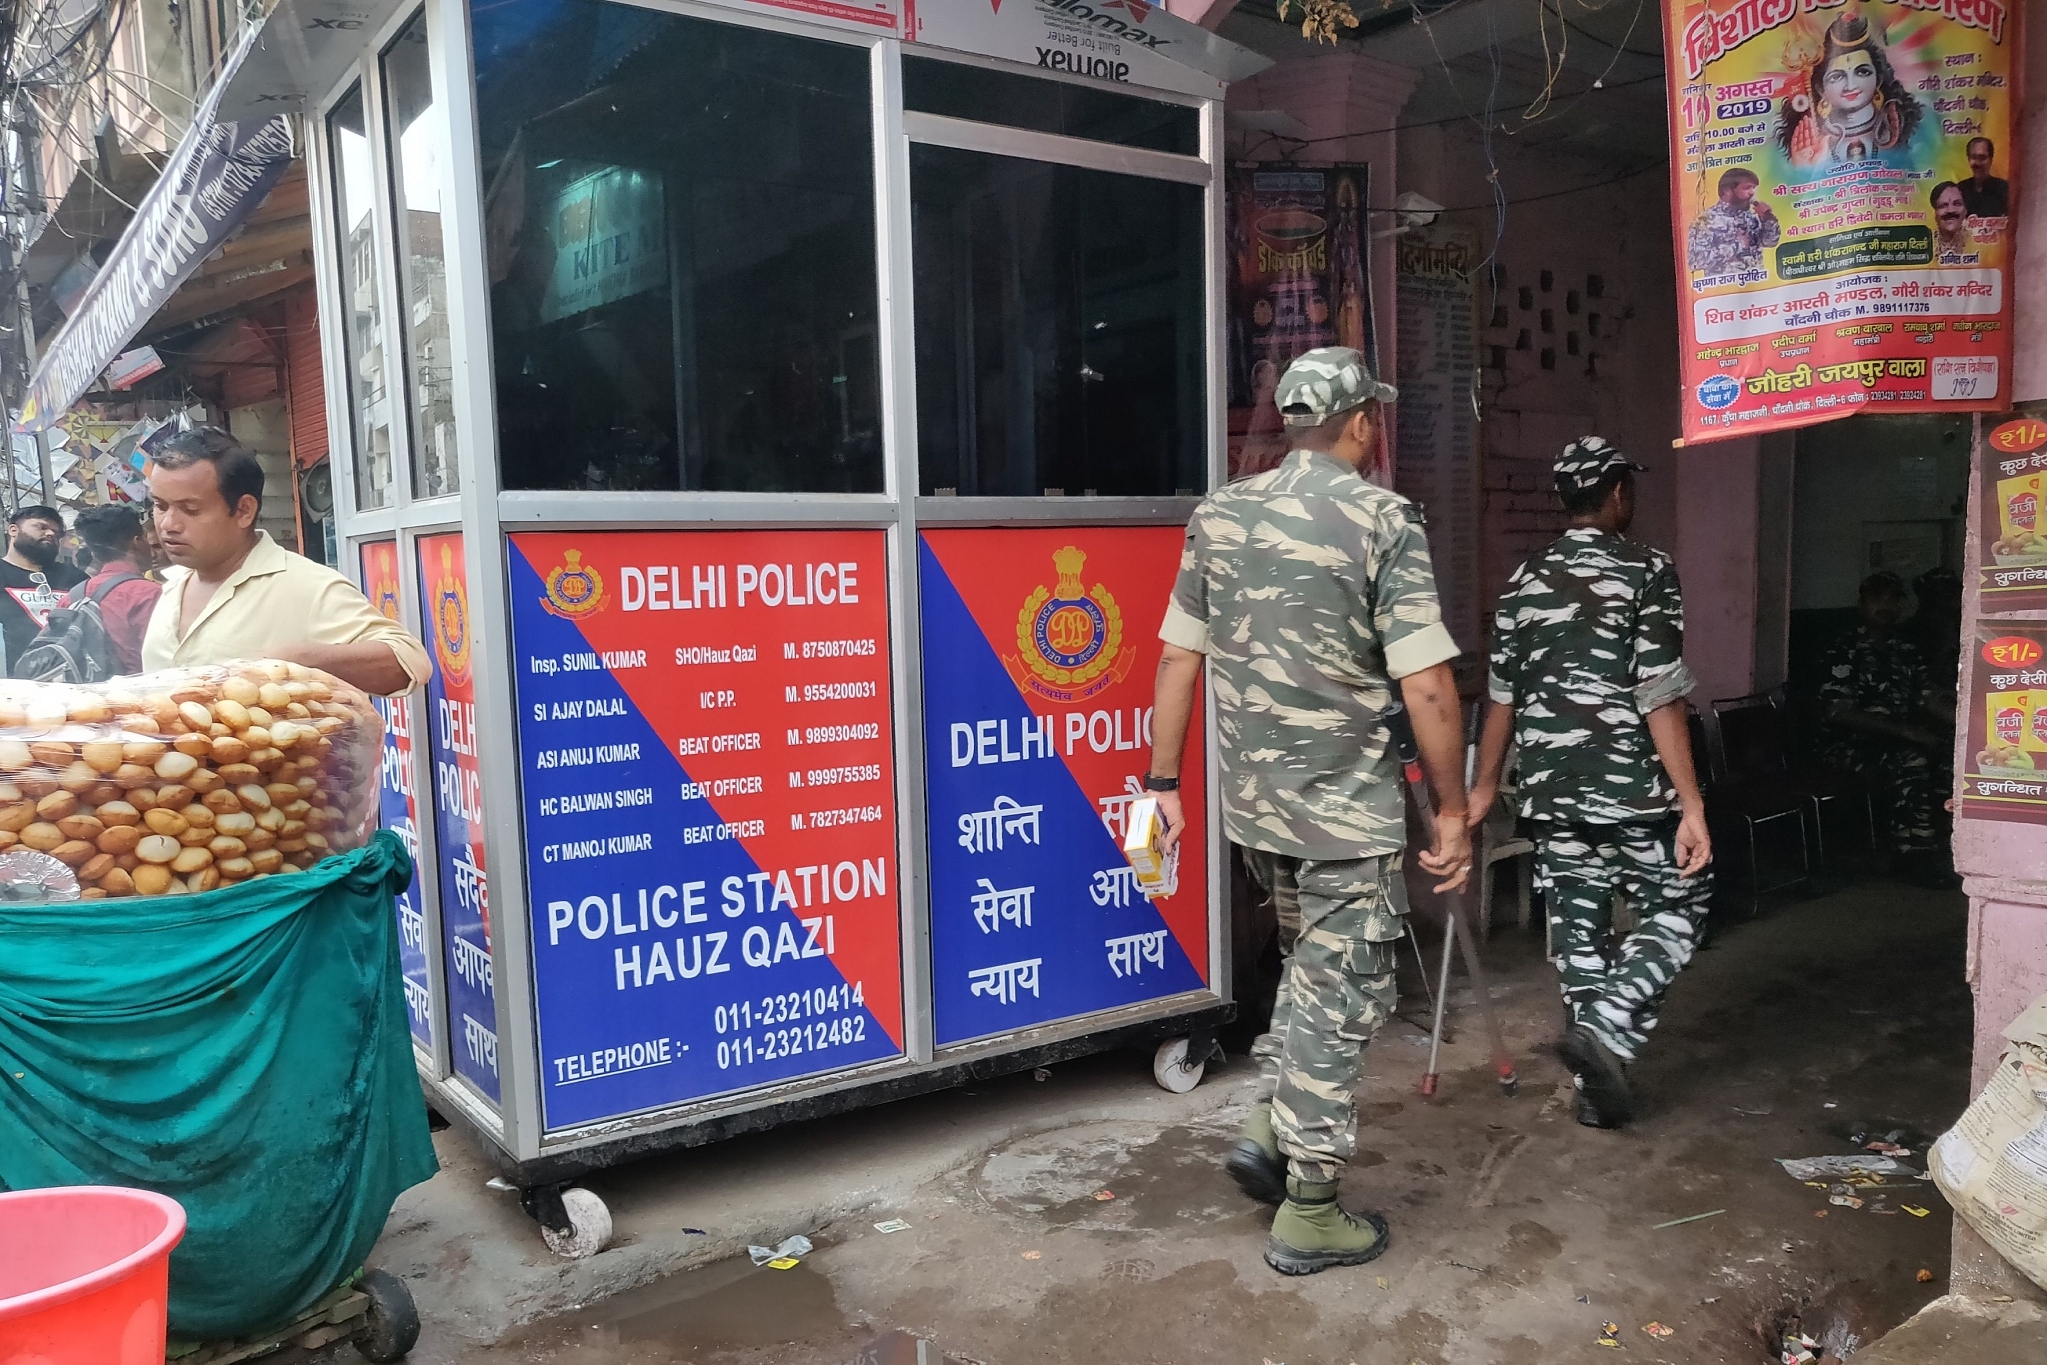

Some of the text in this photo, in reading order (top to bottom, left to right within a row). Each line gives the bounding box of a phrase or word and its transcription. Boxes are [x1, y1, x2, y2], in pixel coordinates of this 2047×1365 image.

[1046, 31, 1121, 56] Built for Better
[1945, 53, 1975, 67] स्थान
[1715, 79, 1773, 102] अगस्त
[1944, 74, 1975, 90] शंकर
[1721, 101, 1768, 118] 2019
[1737, 124, 1754, 135] बजे
[1756, 121, 1766, 133] से
[1718, 136, 1765, 151] आरती तक
[1724, 153, 1753, 166] गायक
[1772, 183, 1788, 197] श्री
[1790, 181, 1818, 195] सत्य
[1821, 170, 1870, 188] नारायण
[1871, 167, 1904, 180] गोयल
[1834, 188, 1848, 200] श्री
[1850, 183, 1880, 197] त्रिलोक
[1798, 198, 1866, 220] श्री उपेन्द्र गुप्ता
[1786, 224, 1799, 238] श्री
[1801, 222, 1826, 235] श्याम
[1827, 216, 1844, 230] हरि
[1846, 210, 1874, 225] द्विवेदी
[91, 256, 136, 360] CHAND
[144, 167, 209, 290] SONS
[1781, 238, 1908, 266] स्वामी हरी शंकरानन्द जी महाराज
[1817, 261, 1827, 273] श्री
[1692, 270, 1768, 293] कृष्णा राज पुरोहित
[1835, 274, 1882, 290] आयोजक
[1704, 279, 1994, 326] शिव शंकर आरती मण्डल, गौरी शंकर मन्दिर
[1784, 301, 1930, 328] चाँदनी चौक M. 9891117376
[1696, 341, 1760, 361] महेन्द्र भारद्वाज
[1771, 329, 1817, 350] प्रदीप वर्मा
[1779, 346, 1811, 359] उपप्रधान
[1718, 358, 1739, 369] प्रधान
[1746, 358, 1927, 395] जौहरी जयपुर वाला
[1848, 391, 1865, 403] फोन
[2000, 458, 2029, 476] कुछ
[619, 564, 727, 612] DELHI
[738, 562, 859, 607] POLICE
[1036, 602, 1062, 664] DELHI POLICE
[531, 638, 876, 677] Insp. SUNIL KUMAR SHO/Hauz Qazi M. 8750870425
[1031, 673, 1111, 702] सत्यमेव जयते
[1990, 674, 2018, 690] कुछ
[534, 681, 877, 721] SI AJAY DALAL I/C P.P. M. 9554200031
[439, 697, 478, 757] DELH
[950, 714, 1055, 768] DELHI
[537, 722, 879, 769] ASI ANUJ KUMAR BEAT OFFICER M. 9899304092
[438, 761, 482, 825] POLIC
[540, 763, 881, 816] HC BALWAN SINGH BEAT OFFICER M. 9999755385
[1976, 780, 2042, 797] सुगन्धित
[542, 804, 883, 863] CT MANOJ KUMAR BEAT OFFICER M. 7827347464
[957, 796, 1043, 855] शान्ति
[547, 856, 887, 946] POLICE STATION
[971, 878, 1035, 934] सेवा
[614, 914, 836, 991] HAUZ QAZI
[968, 929, 1168, 1005] न्याय साथ
[714, 979, 865, 1035] 011-23210414
[463, 1012, 499, 1079] साथ
[554, 1037, 673, 1086] TELEPHONE
[717, 1014, 866, 1070] 011-23212482
